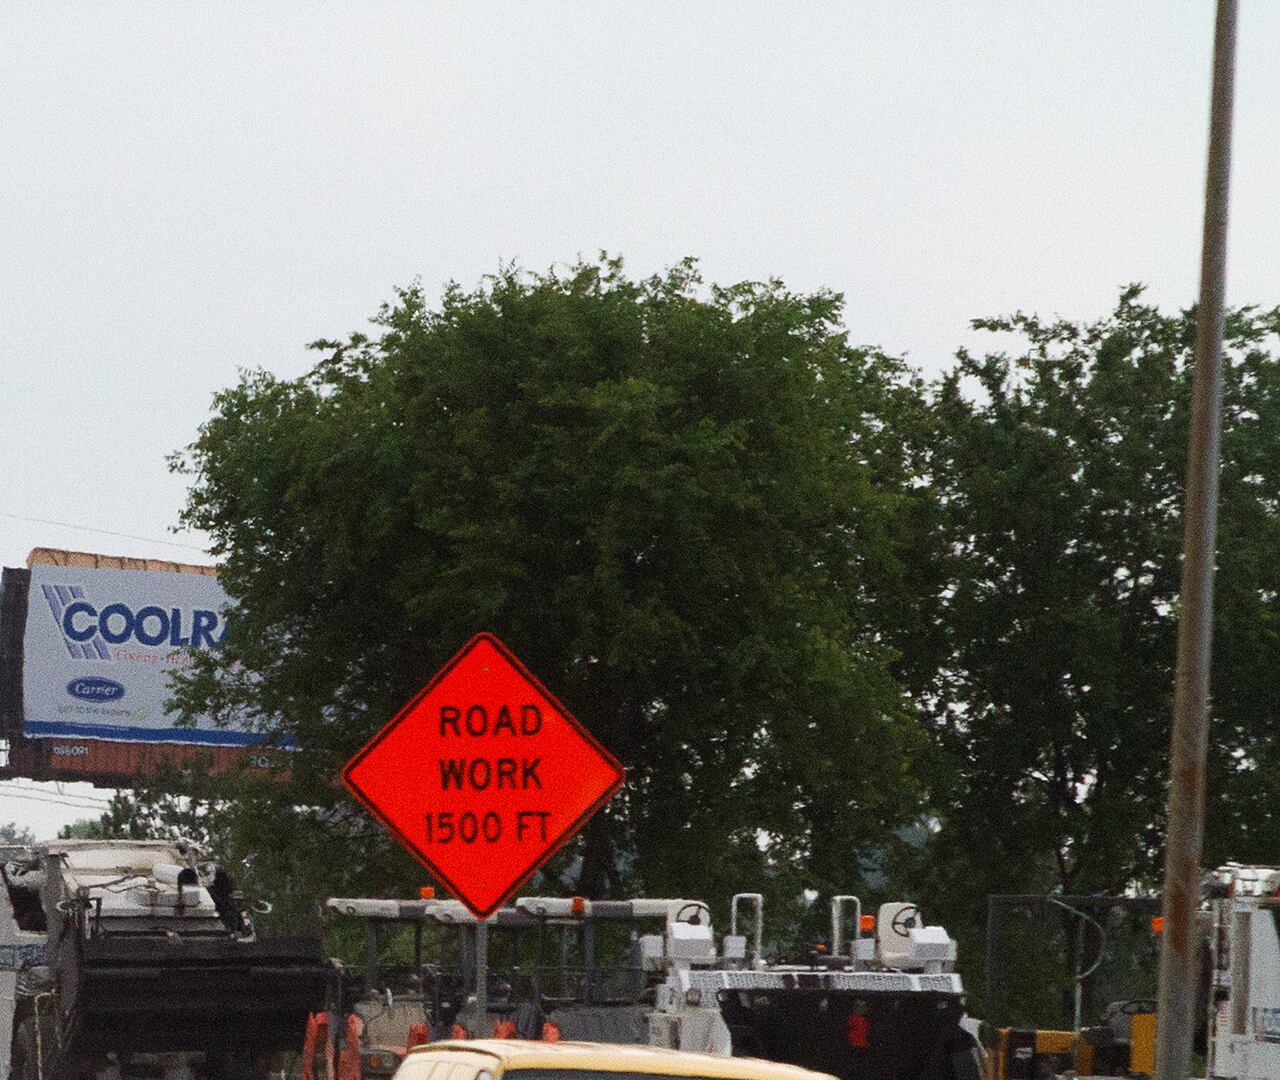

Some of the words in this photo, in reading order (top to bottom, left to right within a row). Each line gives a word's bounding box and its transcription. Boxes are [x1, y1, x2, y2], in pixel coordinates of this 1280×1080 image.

[74, 682, 120, 696] Carrier
[439, 704, 543, 737] ROAD
[439, 757, 544, 791] WORK
[426, 811, 503, 844] 1500
[516, 811, 552, 843] FT
